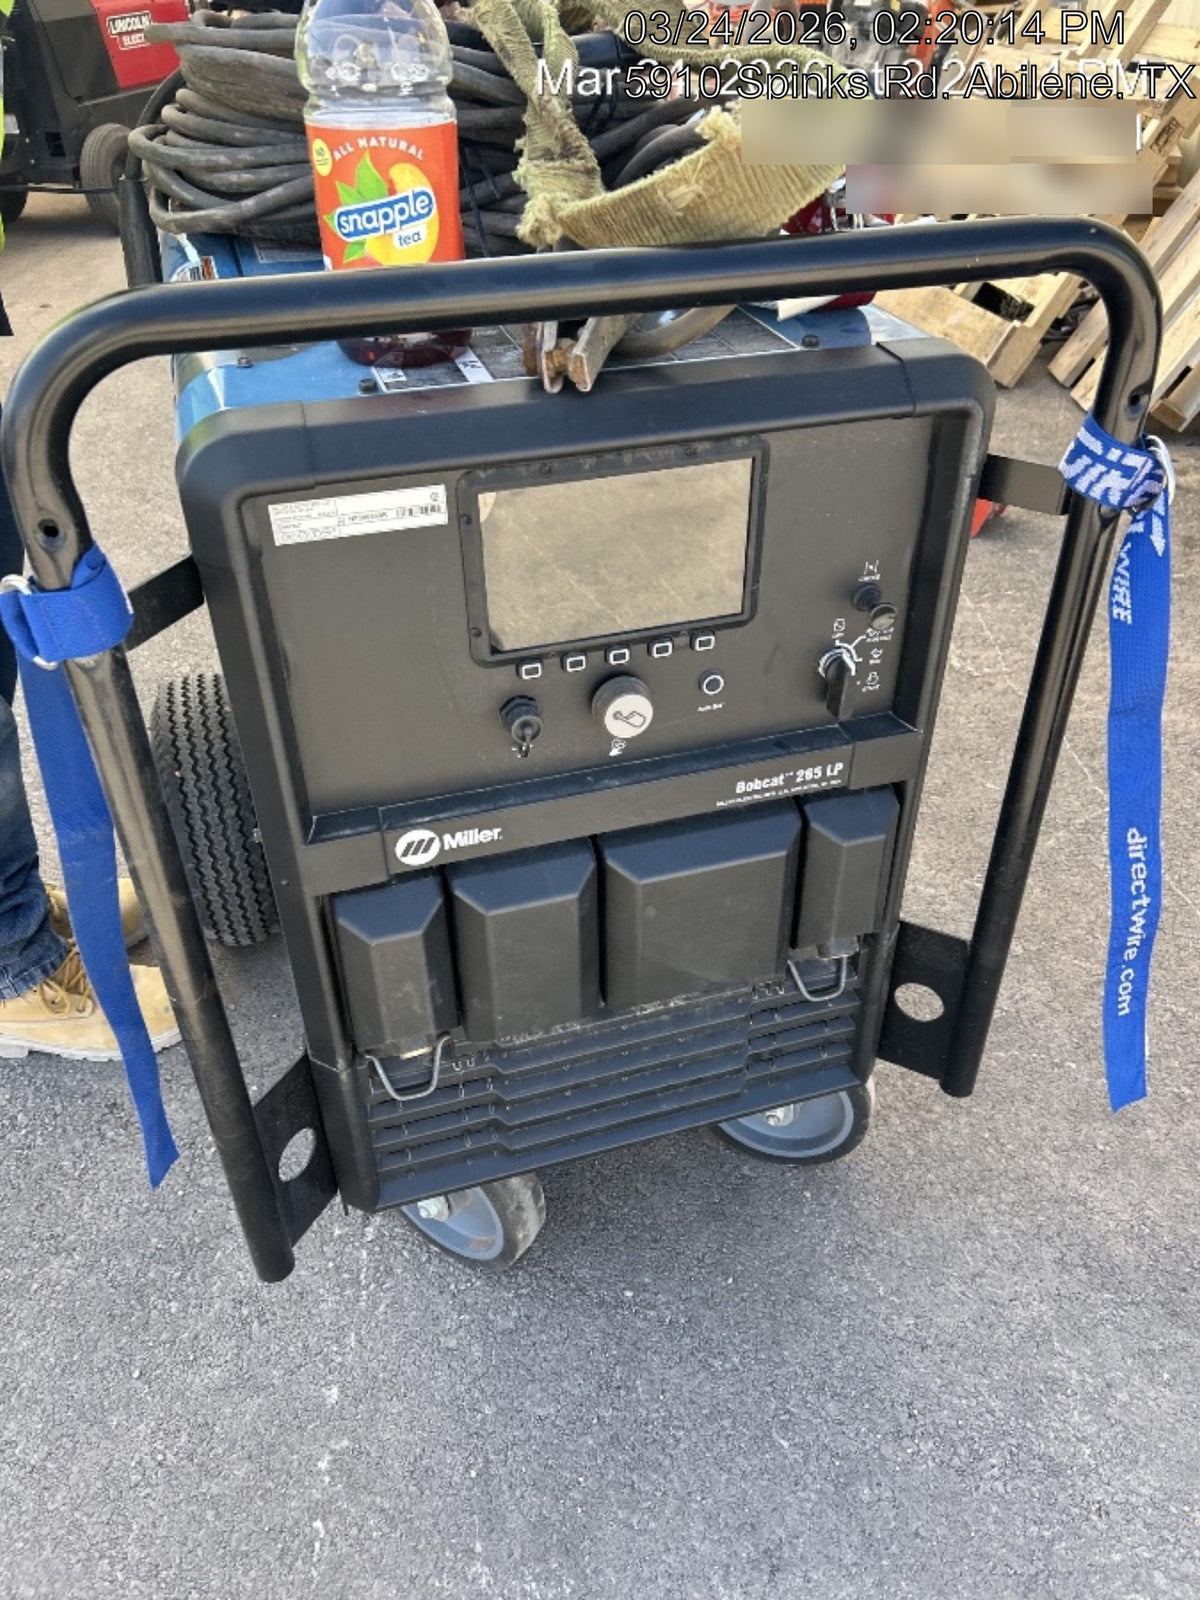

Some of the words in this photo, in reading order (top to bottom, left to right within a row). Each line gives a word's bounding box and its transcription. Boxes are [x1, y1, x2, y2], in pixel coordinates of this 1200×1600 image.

[333, 142, 355, 162] ALL
[357, 136, 424, 160] NATURAL
[339, 190, 430, 234] snapple
[398, 230, 422, 247] tea
[735, 773, 785, 794] Bobcat
[795, 766, 822, 783] 265
[826, 762, 844, 777] LP
